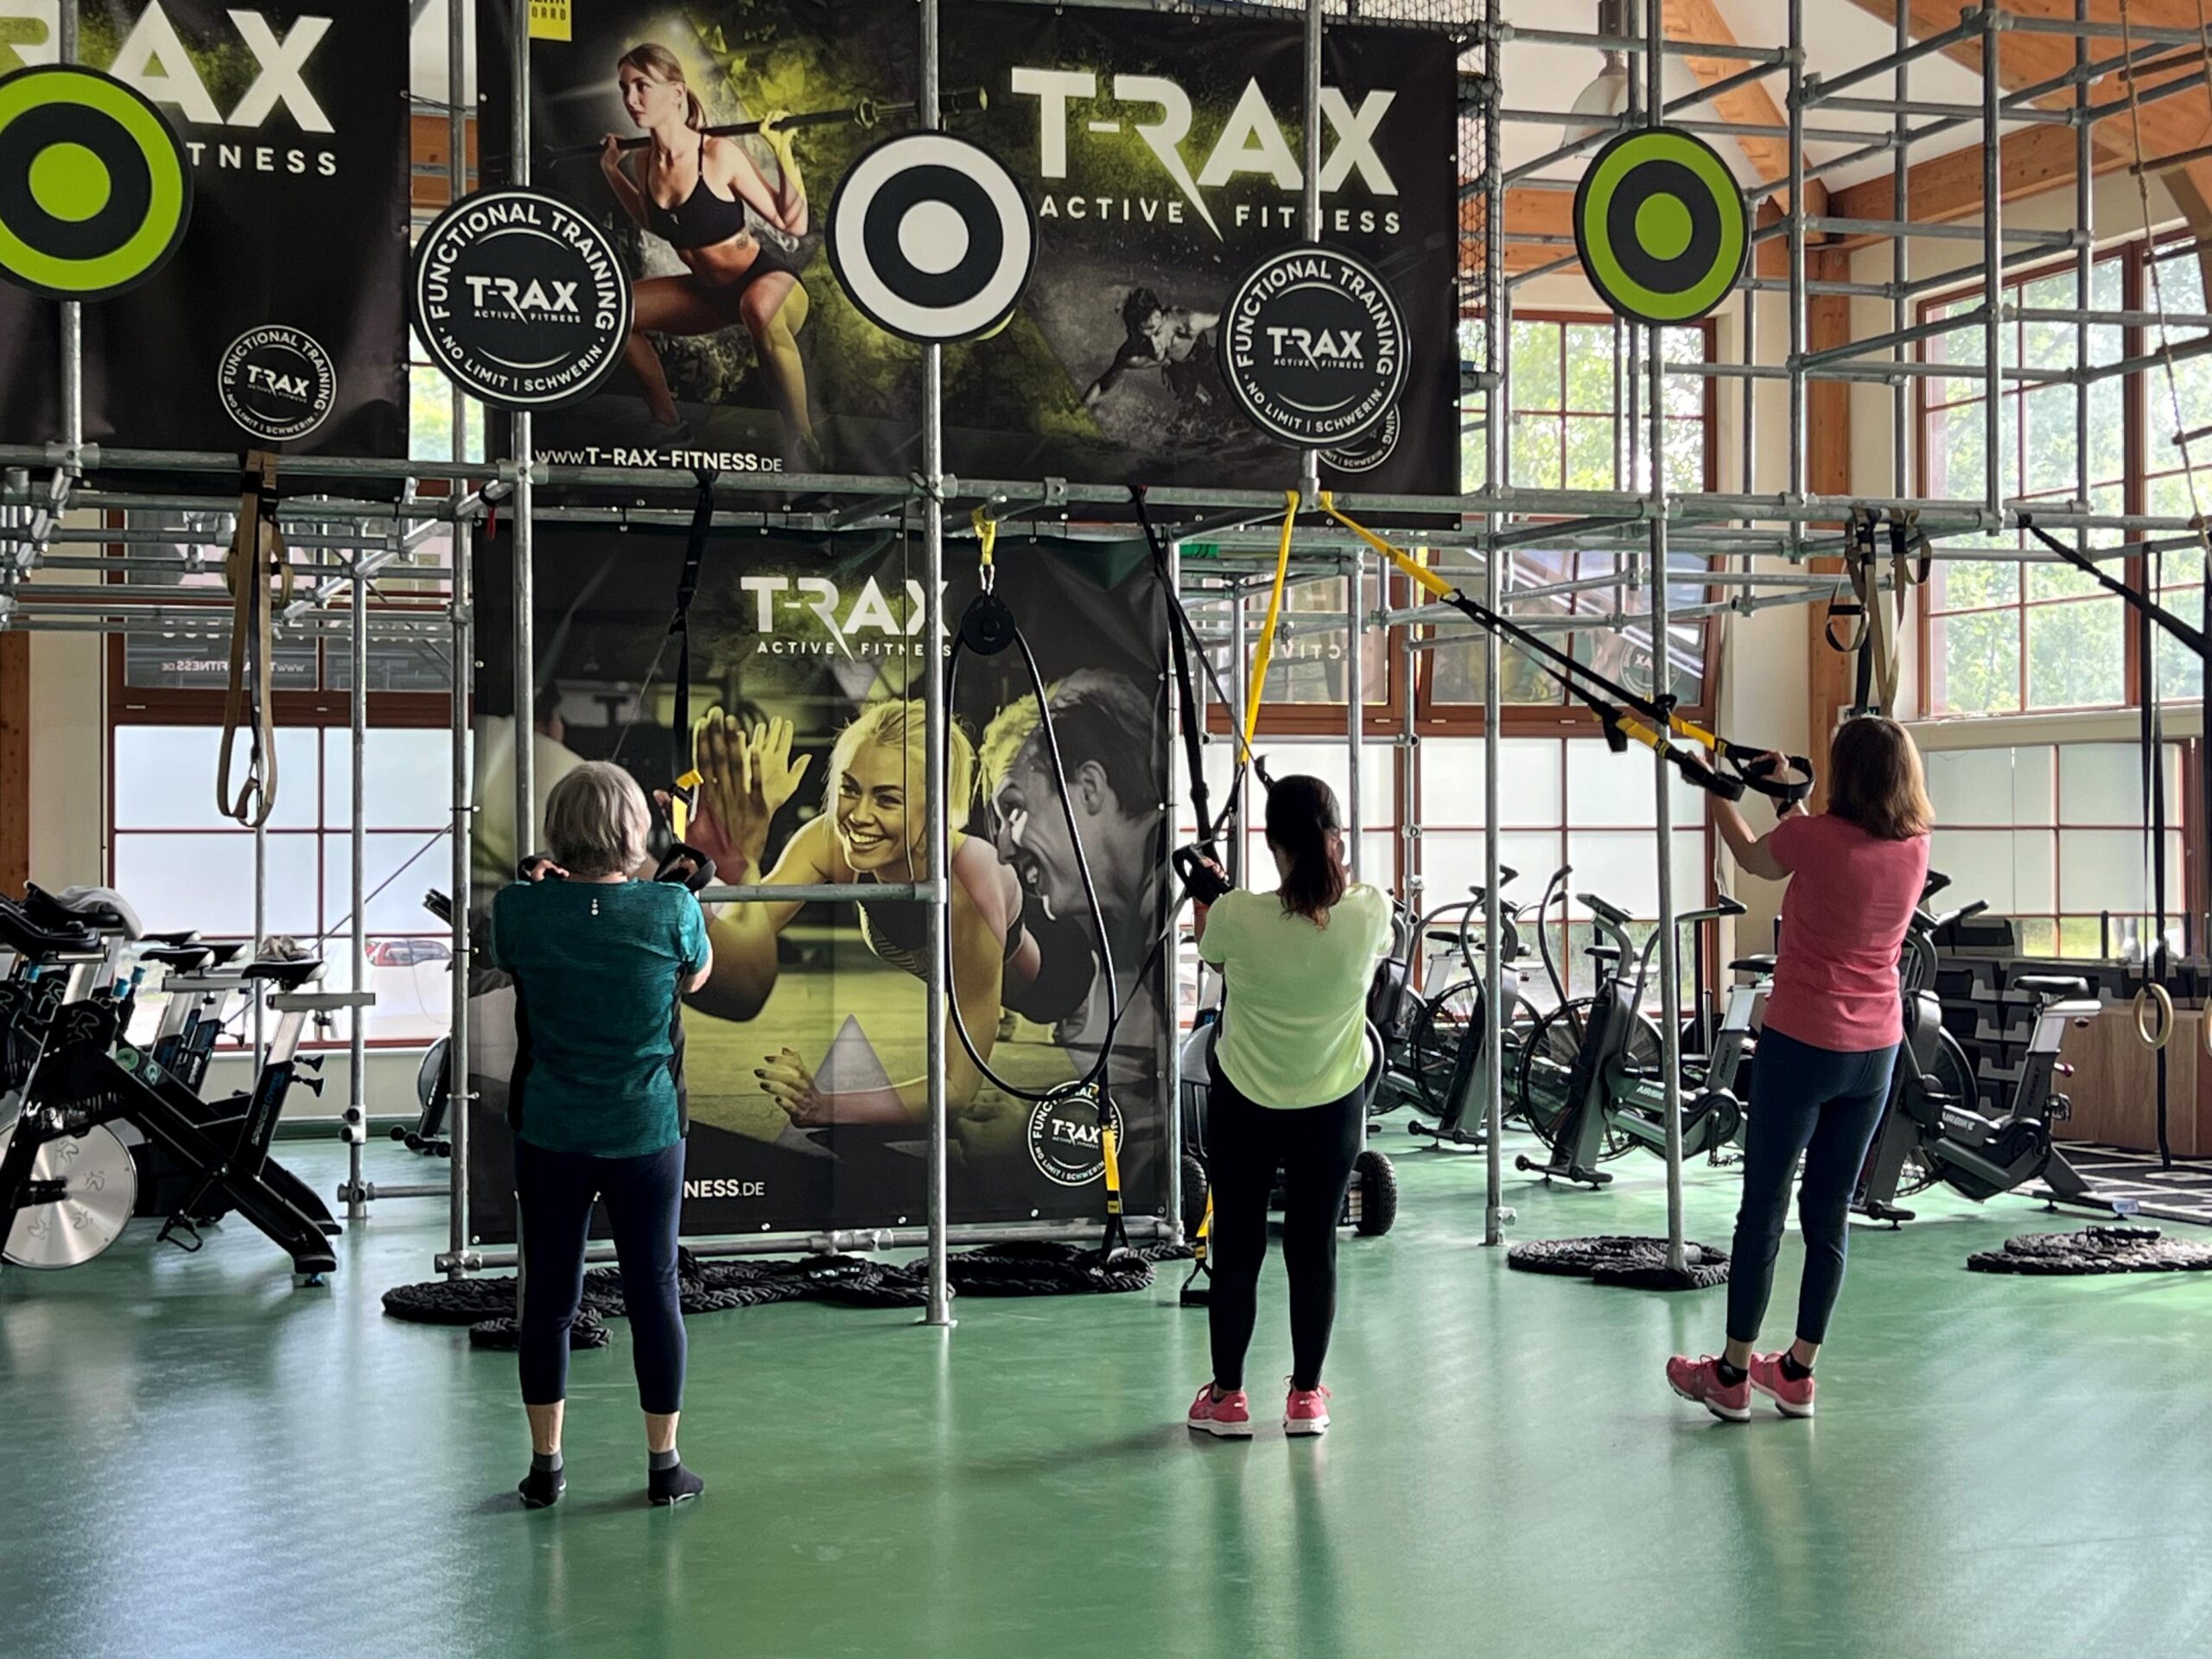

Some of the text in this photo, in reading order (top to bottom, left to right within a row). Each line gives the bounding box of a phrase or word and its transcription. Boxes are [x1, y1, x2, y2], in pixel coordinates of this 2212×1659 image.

[1012, 67, 1398, 243] T-RAX
[1039, 194, 1401, 234] ACTIVE FITESS
[428, 202, 618, 331] FUNCTIONAL TRAINING
[465, 275, 579, 325] T-RAX
[474, 309, 582, 324] ACTIVE FITNESS
[1234, 258, 1395, 377] FUNCTIONAL TRAINING
[224, 330, 331, 410] FUNCTIONAL TRAINING
[442, 335, 603, 392] NO LIMIT SCHWERIN
[1266, 327, 1363, 372] T-RAX
[1273, 358, 1365, 370] ACTIVE FITNESS
[246, 364, 310, 397] T-RAX
[1246, 381, 1382, 433] NO LIMIT SCHWERIN
[740, 575, 951, 664] T-RAX
[757, 641, 951, 657] ACTIVE FITNES
[1052, 1118, 1102, 1147] T-RAX
